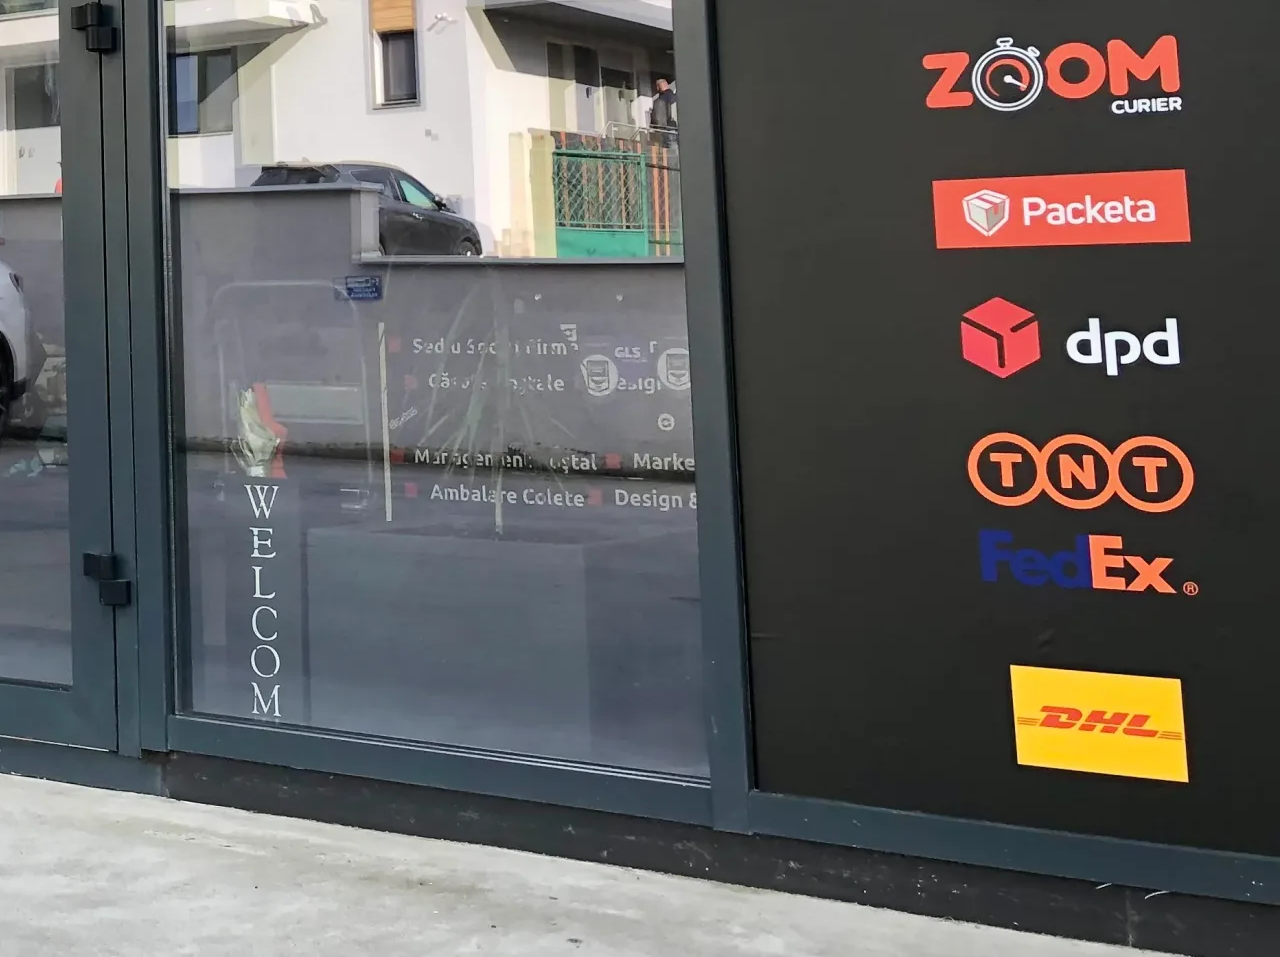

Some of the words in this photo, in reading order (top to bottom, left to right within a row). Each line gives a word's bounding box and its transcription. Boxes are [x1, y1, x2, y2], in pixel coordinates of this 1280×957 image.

[1111, 95, 1183, 115] CURIER
[1023, 195, 1156, 226] Packeta
[1065, 317, 1181, 376] dpd
[978, 443, 1181, 503] TNT
[523, 488, 586, 507] Colete
[614, 489, 683, 511] Design
[978, 528, 1177, 594] FedEx
[1038, 705, 1160, 738] DHL
